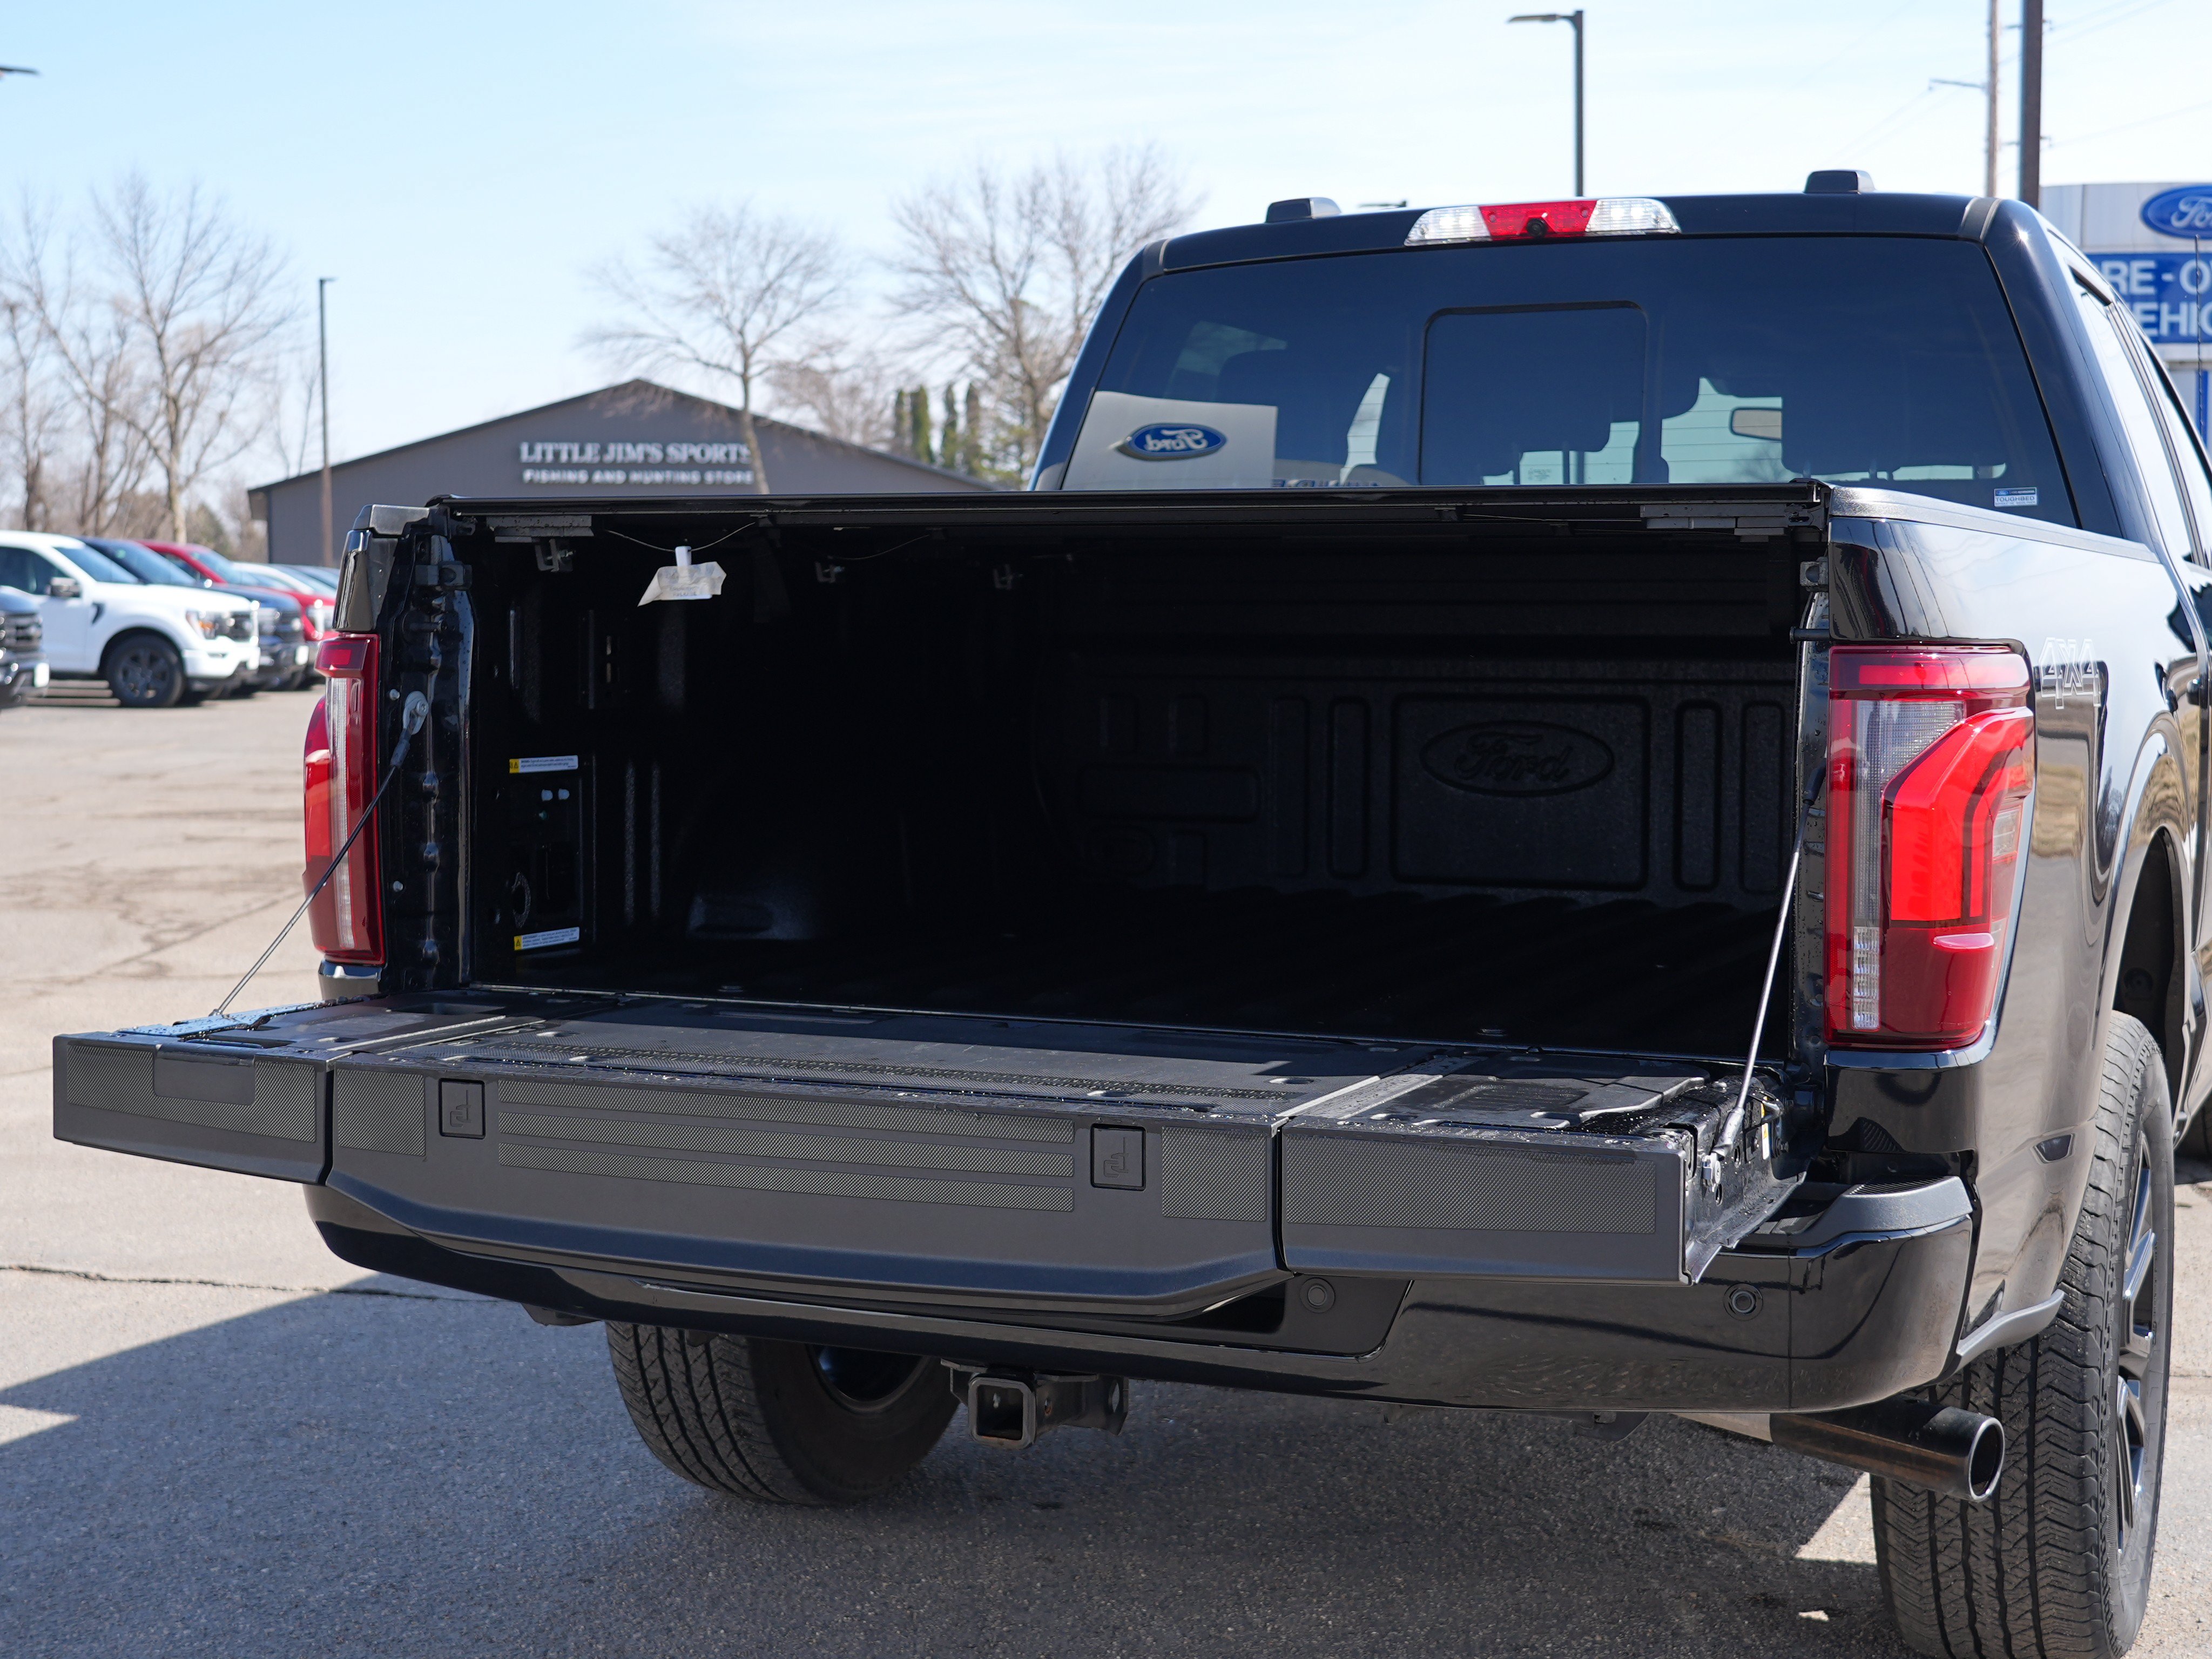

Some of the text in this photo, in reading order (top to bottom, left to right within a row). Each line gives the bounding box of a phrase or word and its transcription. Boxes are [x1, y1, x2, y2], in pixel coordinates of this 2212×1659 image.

[2170, 195, 2212, 228] Fo
[2095, 259, 2212, 295] RE-O
[2128, 300, 2212, 336] EHI
[520, 442, 752, 464] LITTLE JIM'S SPORTS
[523, 469, 754, 484] FISHING AND HUNTING STORE
[1454, 730, 1574, 783] Ford
